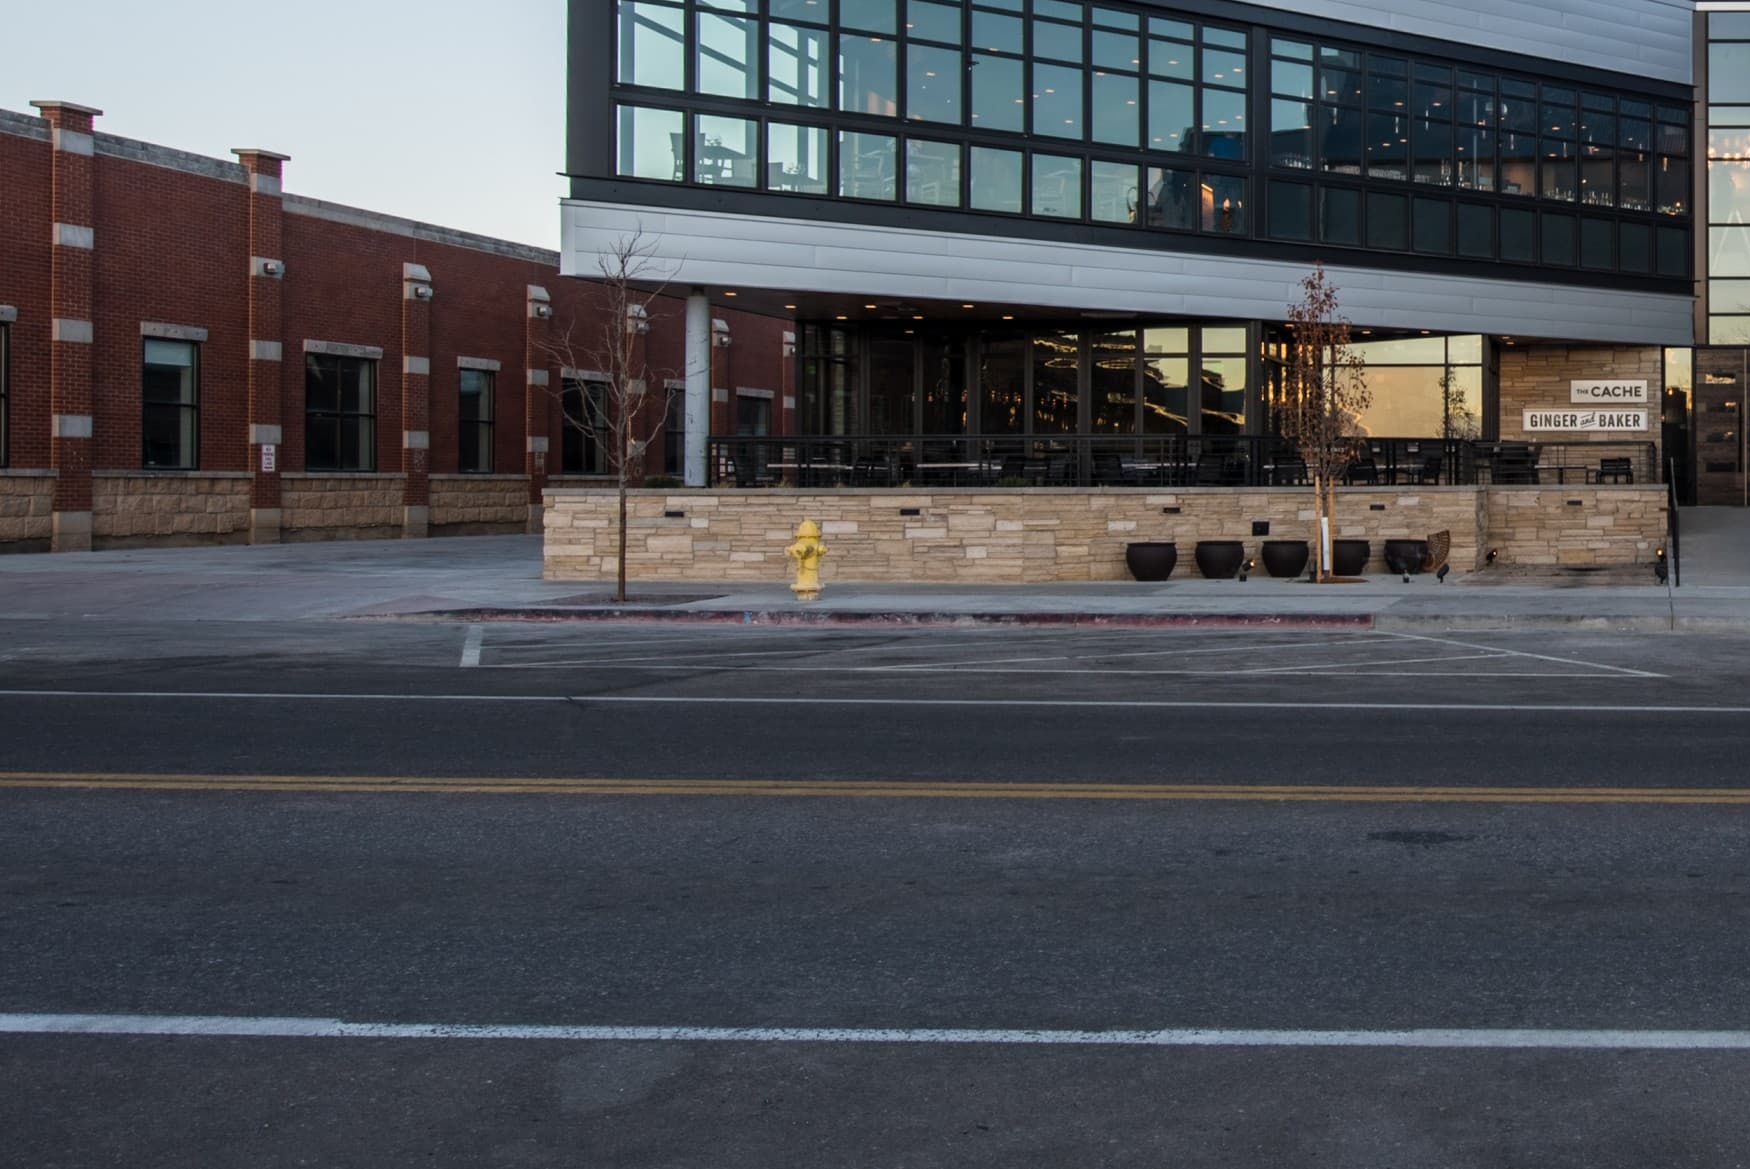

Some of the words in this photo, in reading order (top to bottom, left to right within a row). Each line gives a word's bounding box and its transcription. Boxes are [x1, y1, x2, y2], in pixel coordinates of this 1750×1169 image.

[1591, 386, 1642, 398] CACHE
[1530, 414, 1577, 428] GINGER
[1580, 412, 1596, 426] and
[1599, 414, 1641, 428] BAKER
